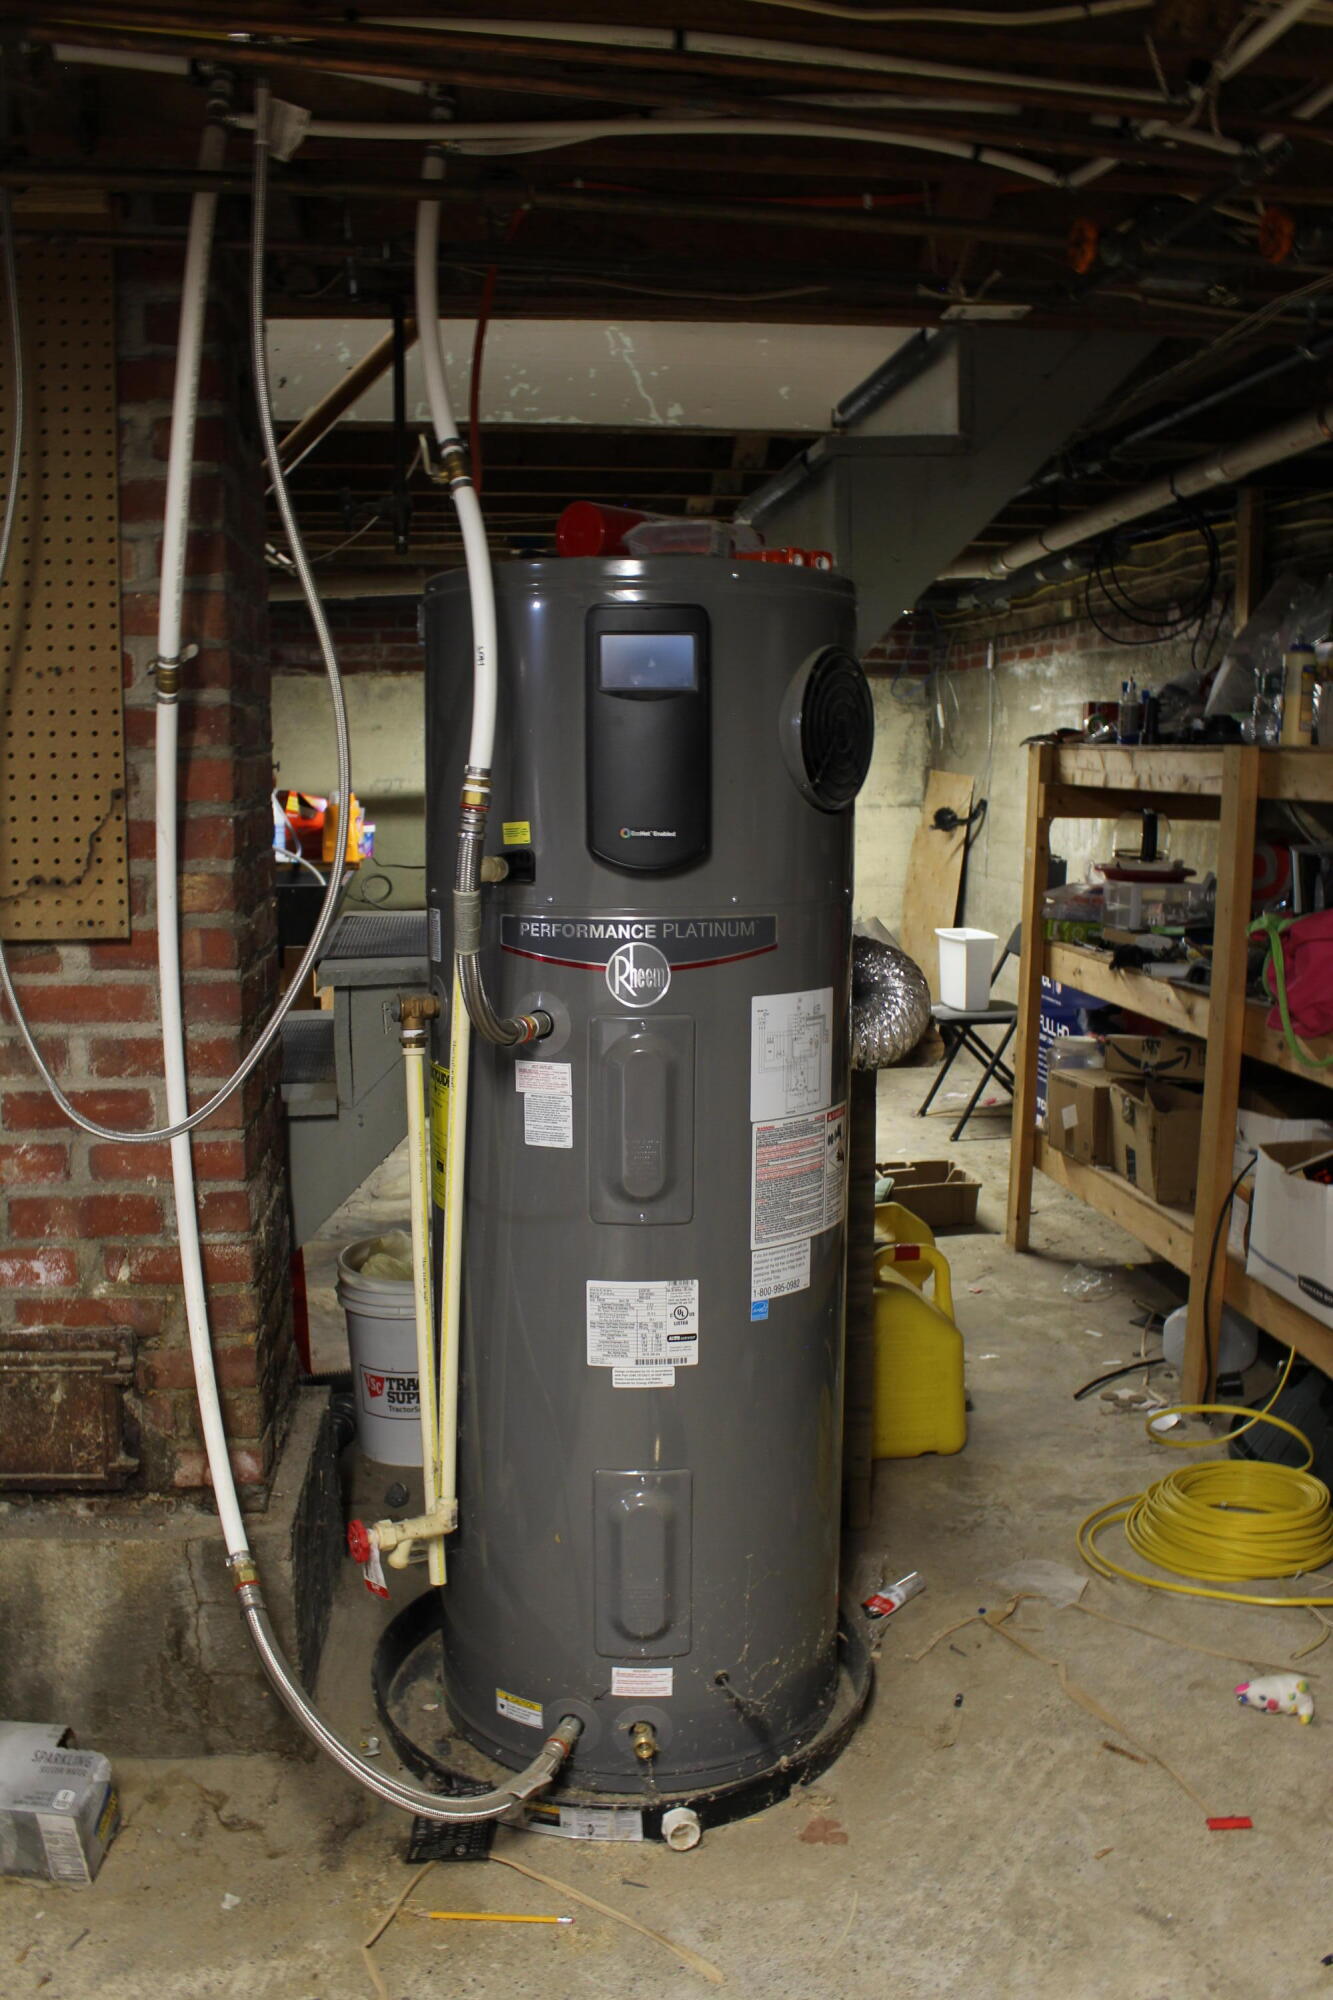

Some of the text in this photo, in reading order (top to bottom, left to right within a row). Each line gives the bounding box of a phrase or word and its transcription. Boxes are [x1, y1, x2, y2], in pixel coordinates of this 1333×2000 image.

[519, 920, 756, 940] PERFORMANCE PLATINUM
[614, 944, 665, 997] Rheem
[32, 1749, 94, 1768] SPARKLING
